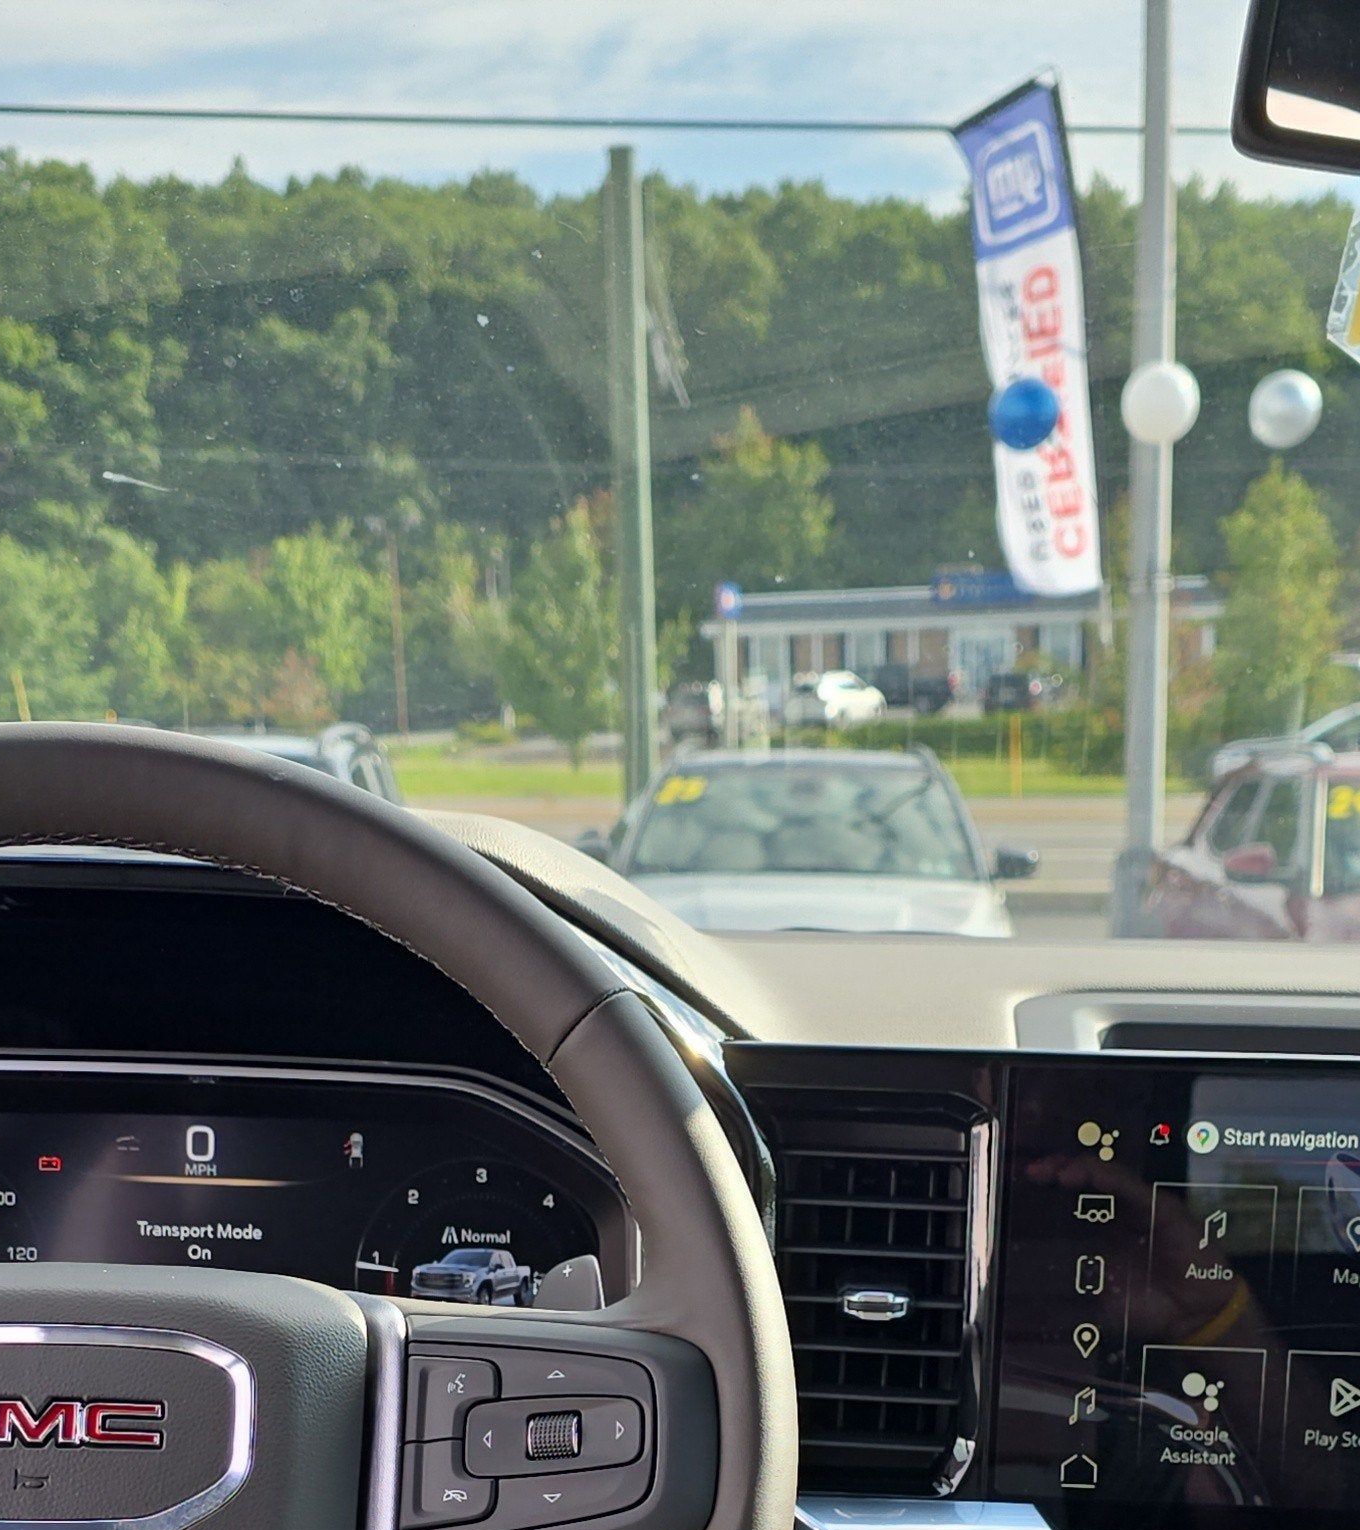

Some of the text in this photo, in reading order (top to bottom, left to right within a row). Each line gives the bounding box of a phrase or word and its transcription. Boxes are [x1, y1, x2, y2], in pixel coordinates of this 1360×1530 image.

[186, 1124, 215, 1162] 0
[1223, 1128, 1359, 1151] Start navigation
[184, 1163, 217, 1176] MPH
[475, 1168, 488, 1184] 3
[407, 1188, 420, 1204] 2
[542, 1193, 555, 1209] 4
[136, 1220, 263, 1241] Transport Mode
[460, 1229, 511, 1245] Normal
[6, 1246, 38, 1262] 120
[187, 1244, 212, 1260] On
[1185, 1263, 1233, 1281] Audio
[1170, 1424, 1229, 1446] Google
[1304, 1429, 1338, 1451] Play
[1160, 1447, 1236, 1465] Assistant
